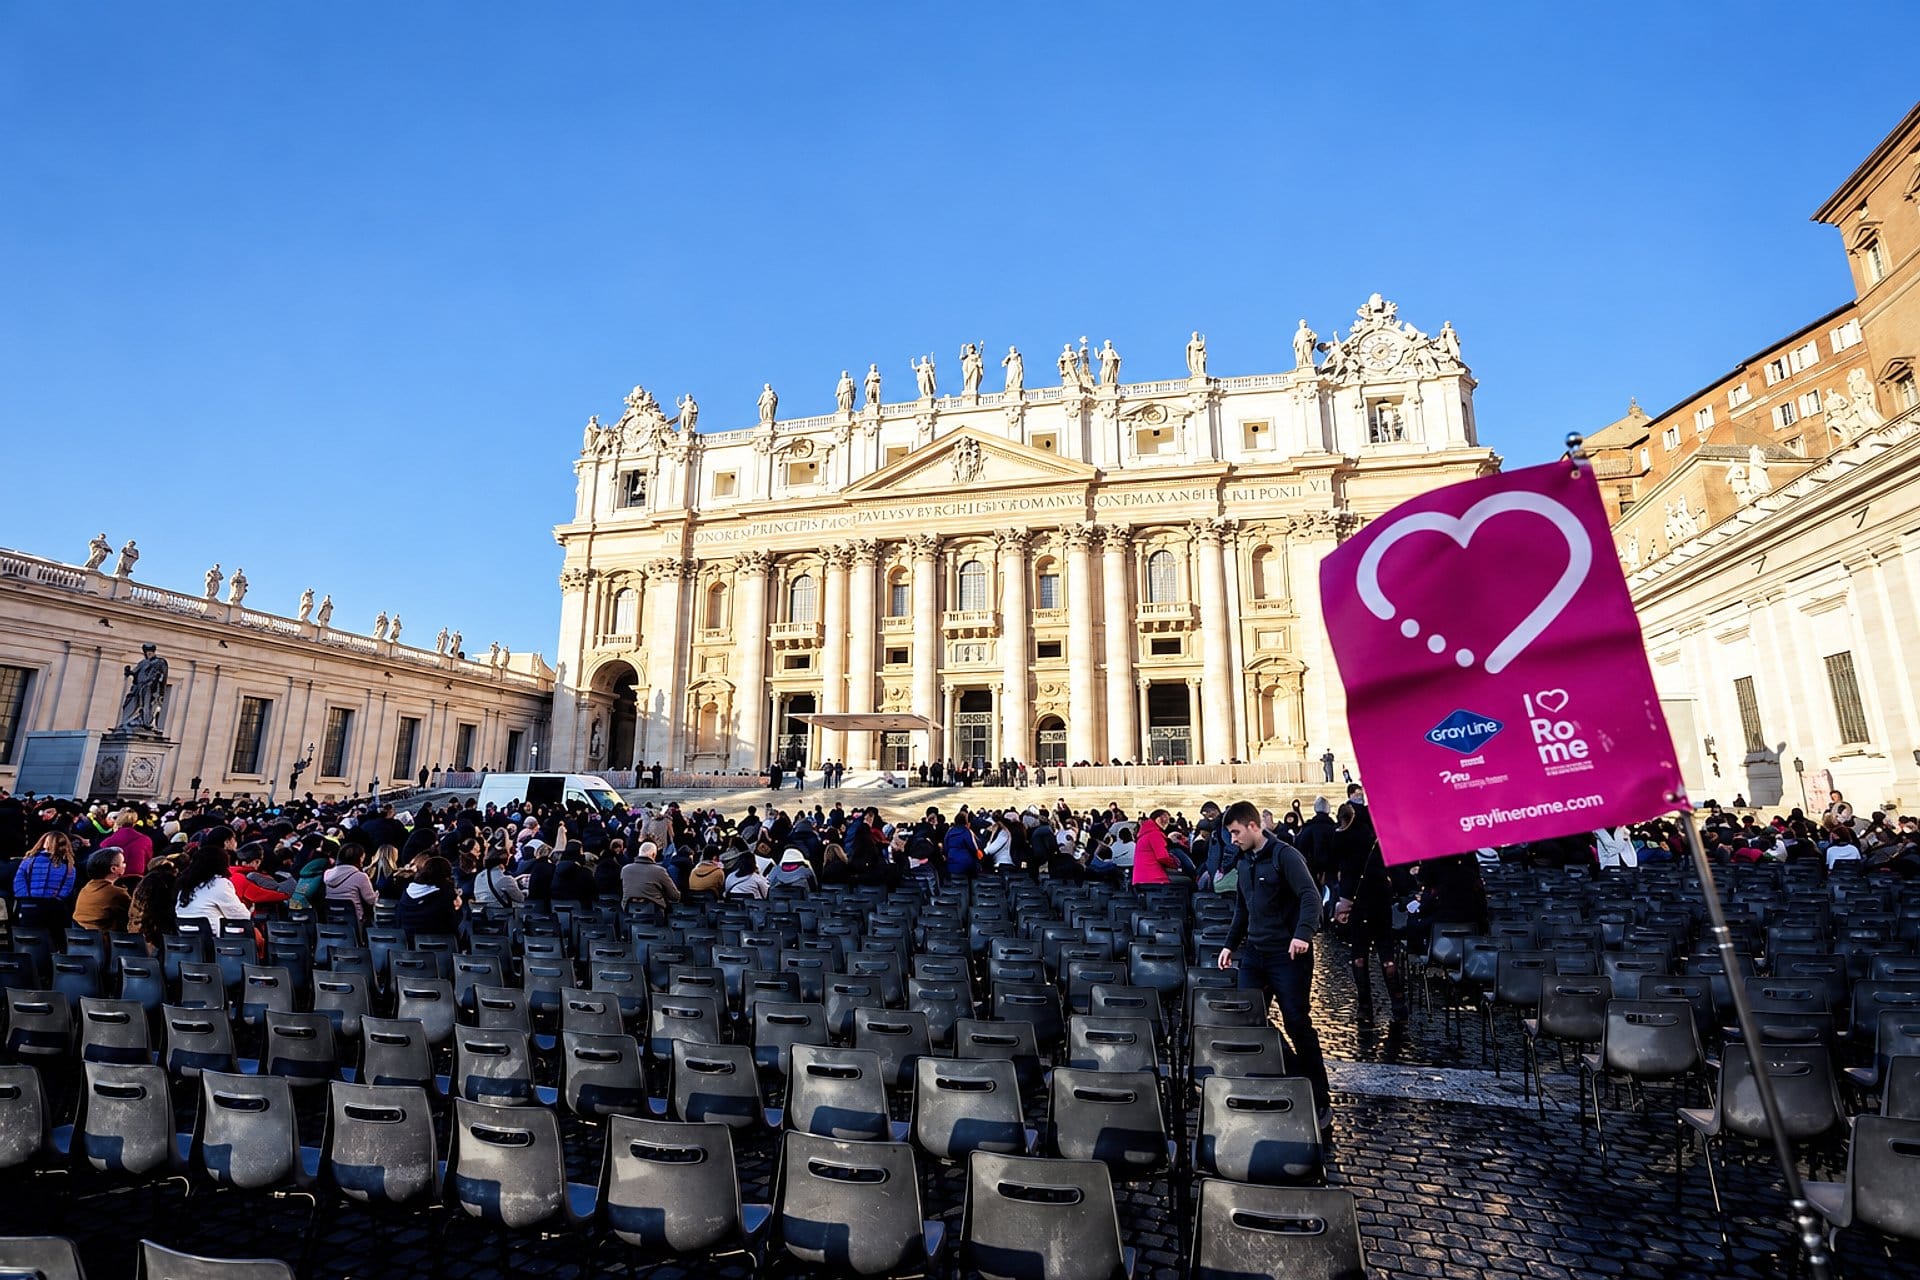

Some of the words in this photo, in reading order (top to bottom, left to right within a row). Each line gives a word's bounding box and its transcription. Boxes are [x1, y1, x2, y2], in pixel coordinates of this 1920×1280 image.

[1530, 718, 1575, 744] Ro
[1537, 739, 1589, 764] me
[1459, 794, 1605, 832] graylinerome.com
